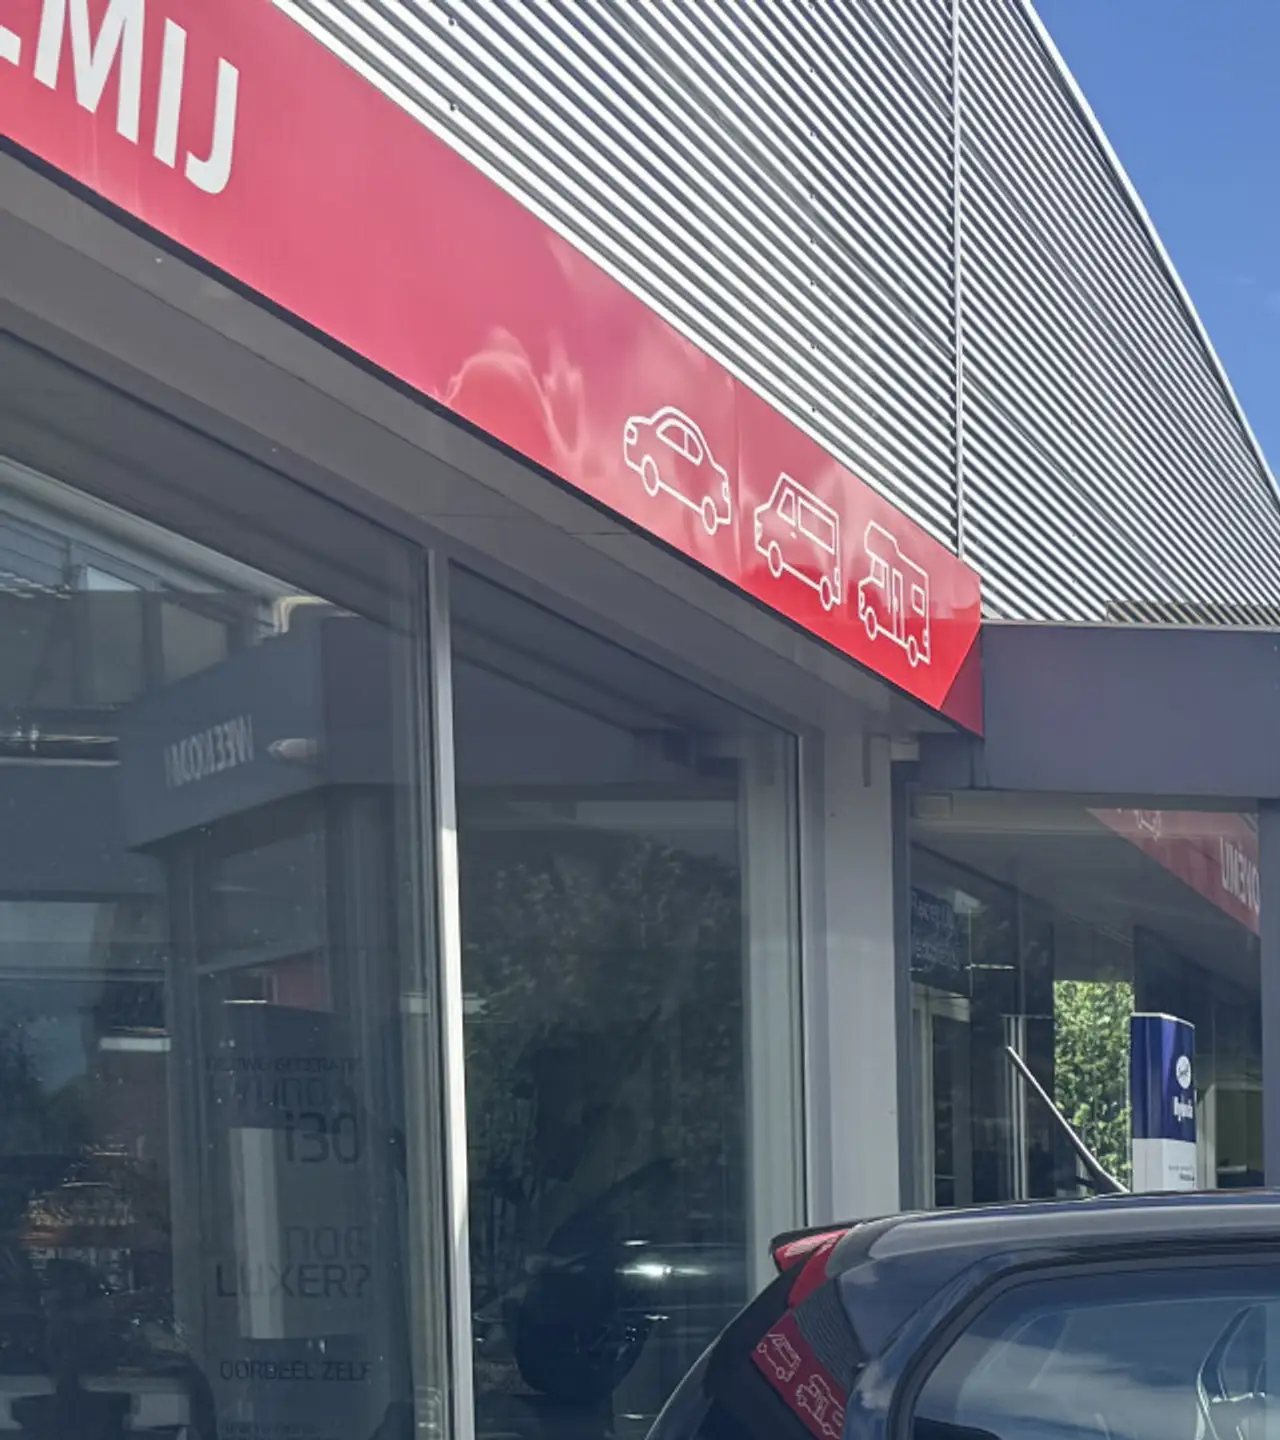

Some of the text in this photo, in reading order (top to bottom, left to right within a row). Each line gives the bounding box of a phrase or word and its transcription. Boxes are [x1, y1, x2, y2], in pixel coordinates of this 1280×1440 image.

[0, 0, 239, 195] MIJ
[284, 1110, 359, 1164] i30
[216, 1264, 371, 1298] LUXER?
[220, 1360, 315, 1380] OORDEEL
